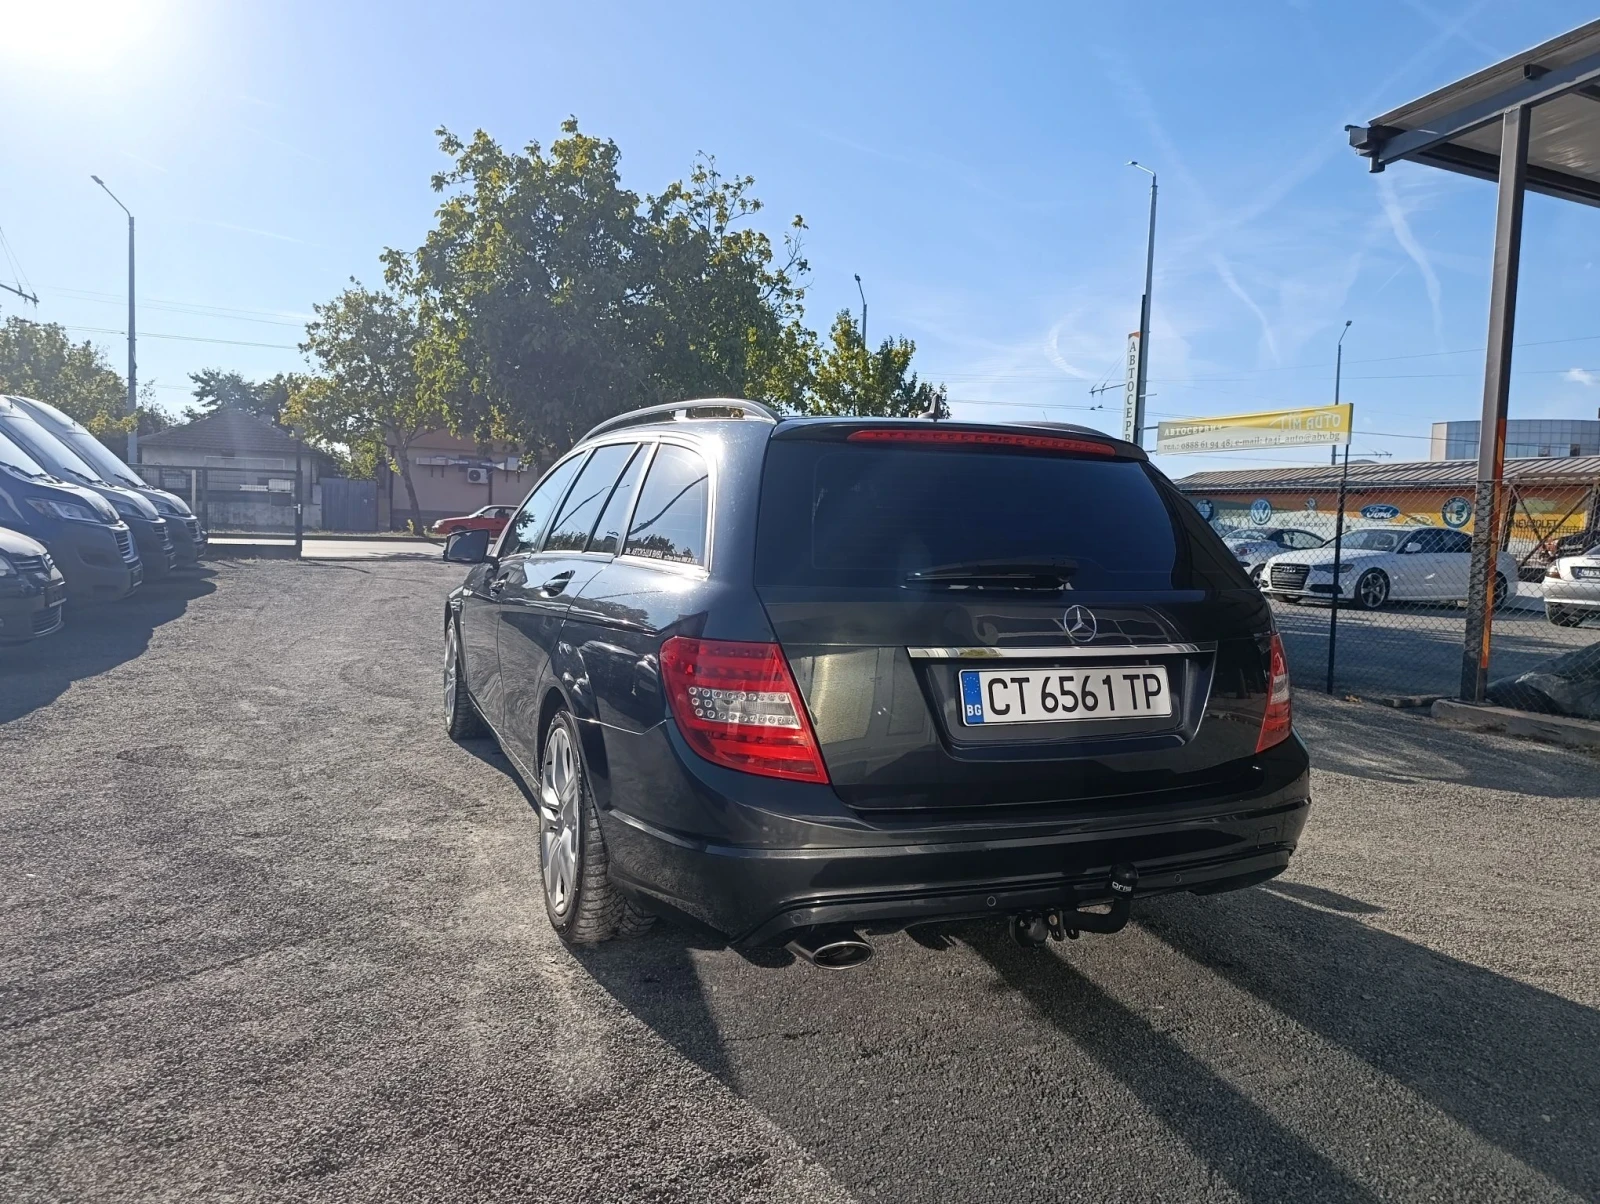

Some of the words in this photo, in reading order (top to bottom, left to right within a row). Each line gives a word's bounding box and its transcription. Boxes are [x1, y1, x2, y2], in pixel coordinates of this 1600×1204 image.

[1306, 414, 1340, 430] AUTO
[1181, 441, 1199, 450] 0888
[1200, 440, 1208, 448] 61
[1366, 507, 1393, 519] Ford
[987, 677, 1030, 716] CT
[1041, 674, 1116, 713] 6561
[1122, 673, 1162, 711] TP
[966, 704, 982, 717] BG
